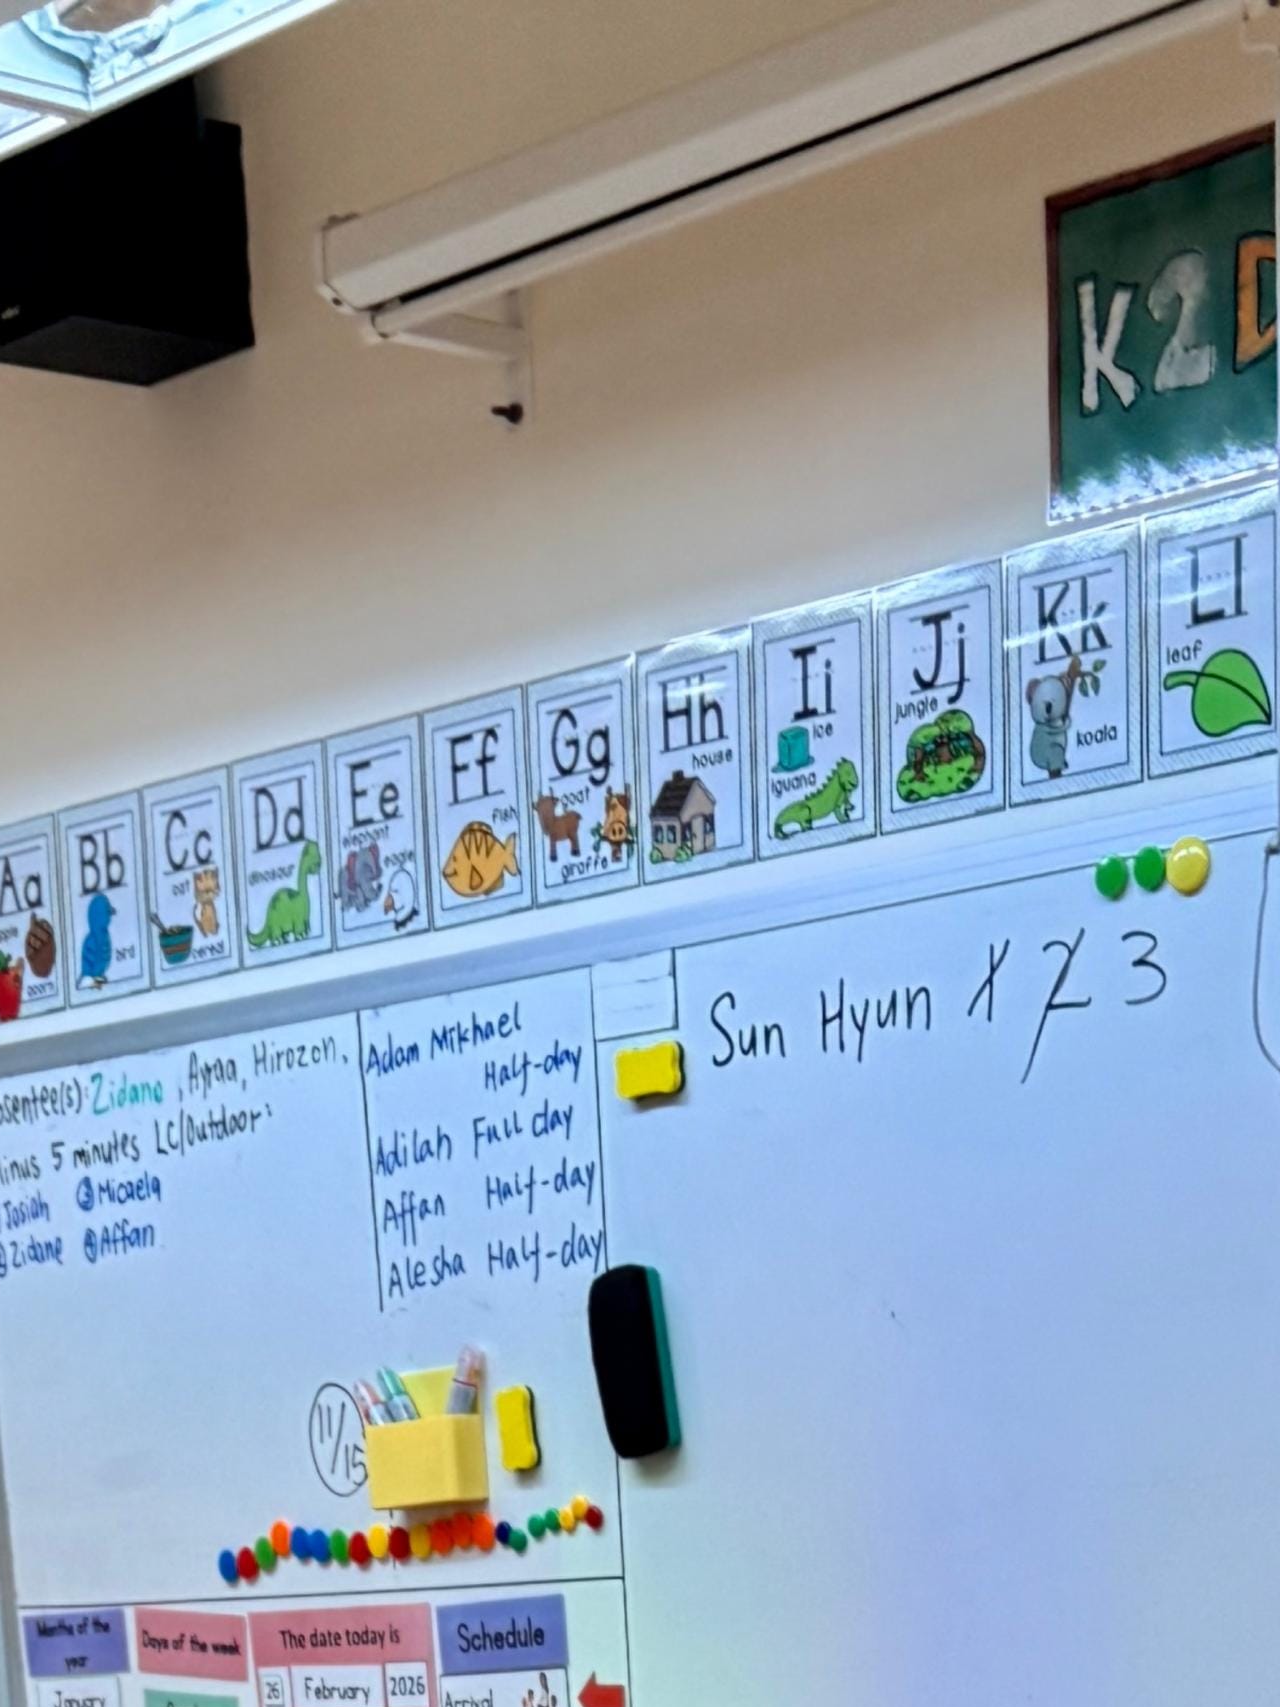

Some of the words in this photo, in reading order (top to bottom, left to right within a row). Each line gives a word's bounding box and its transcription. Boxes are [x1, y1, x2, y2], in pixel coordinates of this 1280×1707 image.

[1076, 247, 1218, 415] K2
[1035, 575, 1111, 664] Kk
[912, 610, 966, 704] Jj
[1166, 641, 1203, 666] leaf
[662, 674, 727, 753] Hh
[894, 697, 938, 724] jungle
[1076, 725, 1118, 749] koala
[448, 728, 499, 804] Ff
[551, 708, 611, 786] Gg
[692, 748, 733, 771] house
[255, 777, 306, 851] Dd
[350, 760, 400, 827] Ee
[80, 829, 126, 895] Bb
[165, 810, 213, 871] Cc
[710, 993, 786, 1068] Sun
[819, 978, 931, 1062] Hyun
[1122, 931, 1168, 1005] 3
[366, 1032, 420, 1077] Adam
[430, 1001, 522, 1060] Mikhael
[484, 1039, 583, 1096] Half-day
[51, 1142, 66, 1170] 5
[72, 1133, 141, 1170] minutes
[376, 1125, 453, 1176] Adilah
[473, 1110, 523, 1159] Full
[531, 1098, 573, 1141] day
[383, 1190, 446, 1247] Affan
[486, 1157, 596, 1215] Half-day
[388, 1245, 466, 1299] Alesha
[487, 1222, 604, 1284] Half-day
[142, 1630, 169, 1653] Days
[172, 1633, 185, 1650] of
[190, 1634, 208, 1653] the
[280, 1628, 306, 1651] The
[308, 1625, 343, 1650] date
[345, 1625, 386, 1653] today
[389, 1624, 401, 1646] is
[456, 1617, 546, 1655] Schedule
[264, 1681, 281, 1701] 26
[303, 1677, 371, 1705] February
[389, 1675, 426, 1698] 2026
